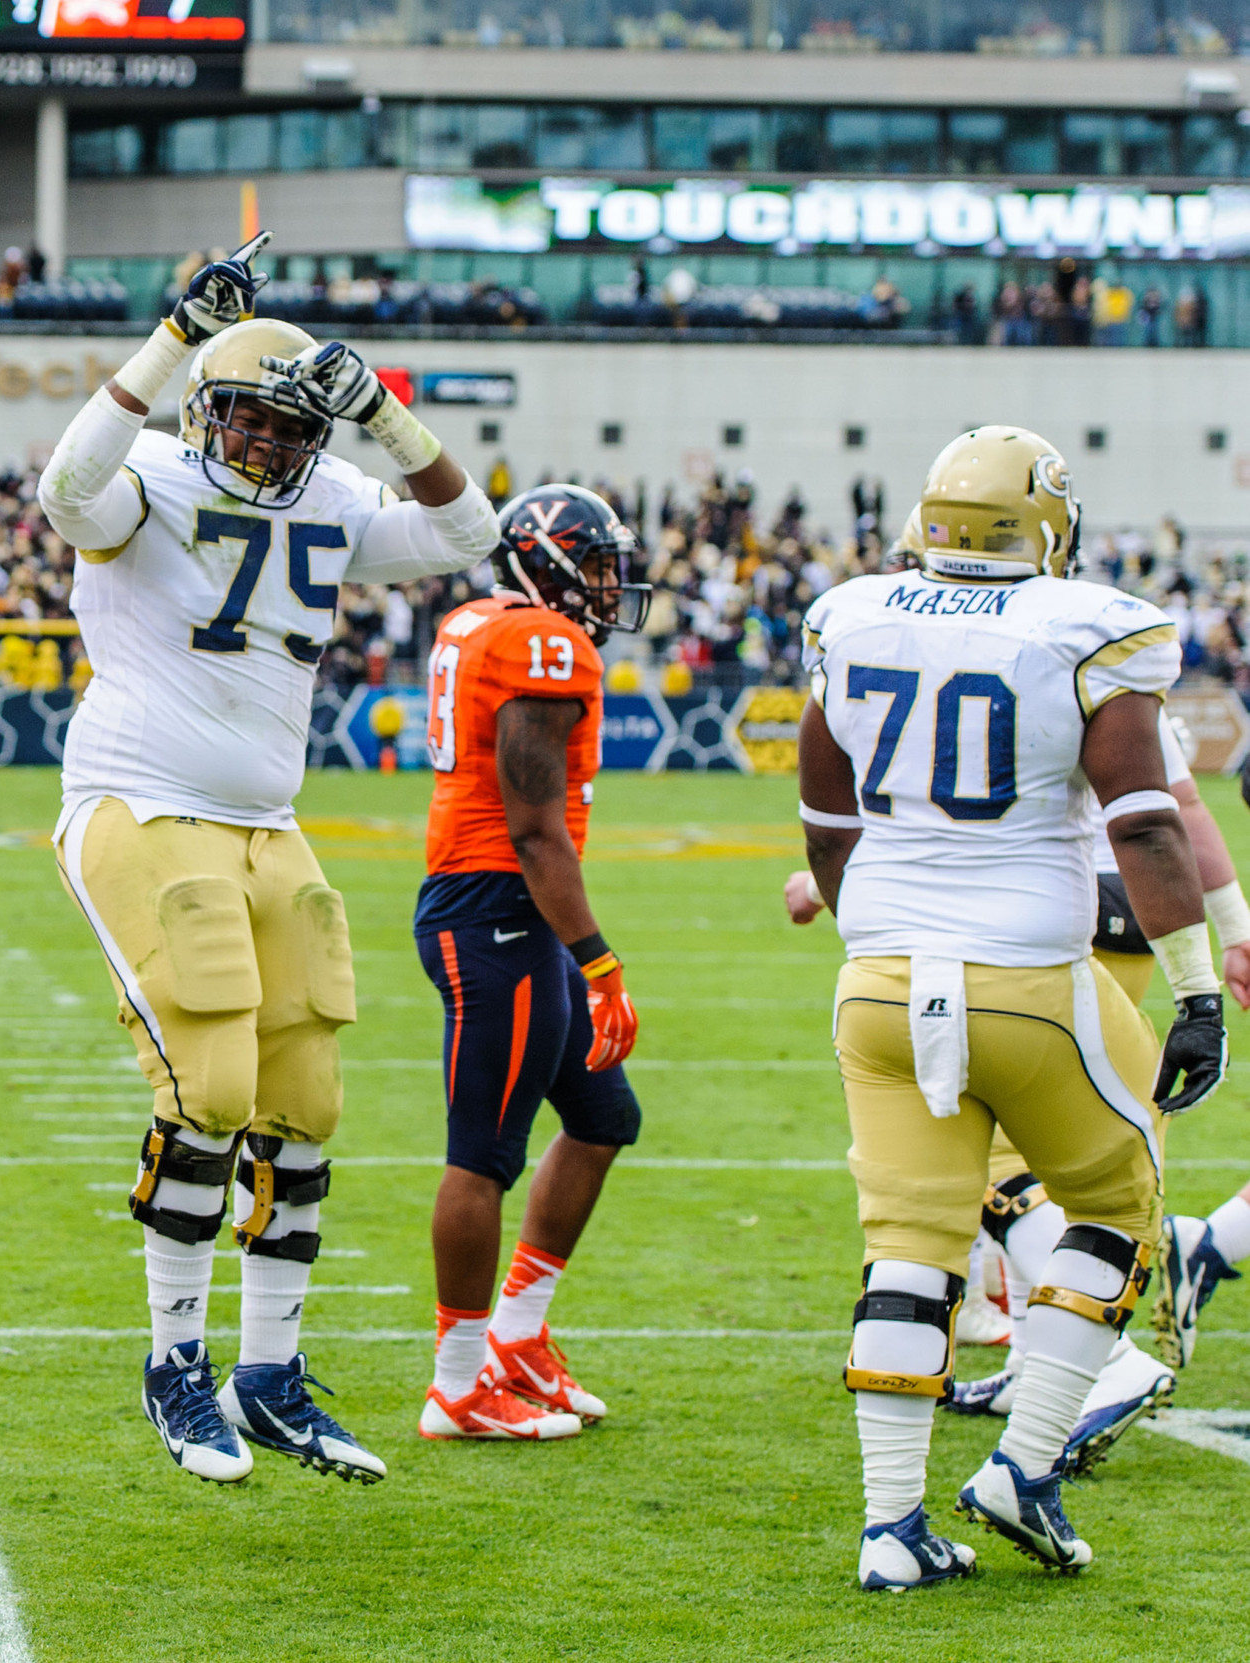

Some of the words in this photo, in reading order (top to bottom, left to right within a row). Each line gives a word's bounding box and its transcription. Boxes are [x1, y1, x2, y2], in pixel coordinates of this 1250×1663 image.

[547, 185, 1214, 249] TOUCHDOWN!
[992, 519, 1020, 529] ACC
[190, 506, 349, 664] 75
[942, 560, 988, 573] JACKETS
[885, 585, 1020, 616] MASON
[528, 635, 574, 681] 13
[846, 661, 1019, 823] 70
